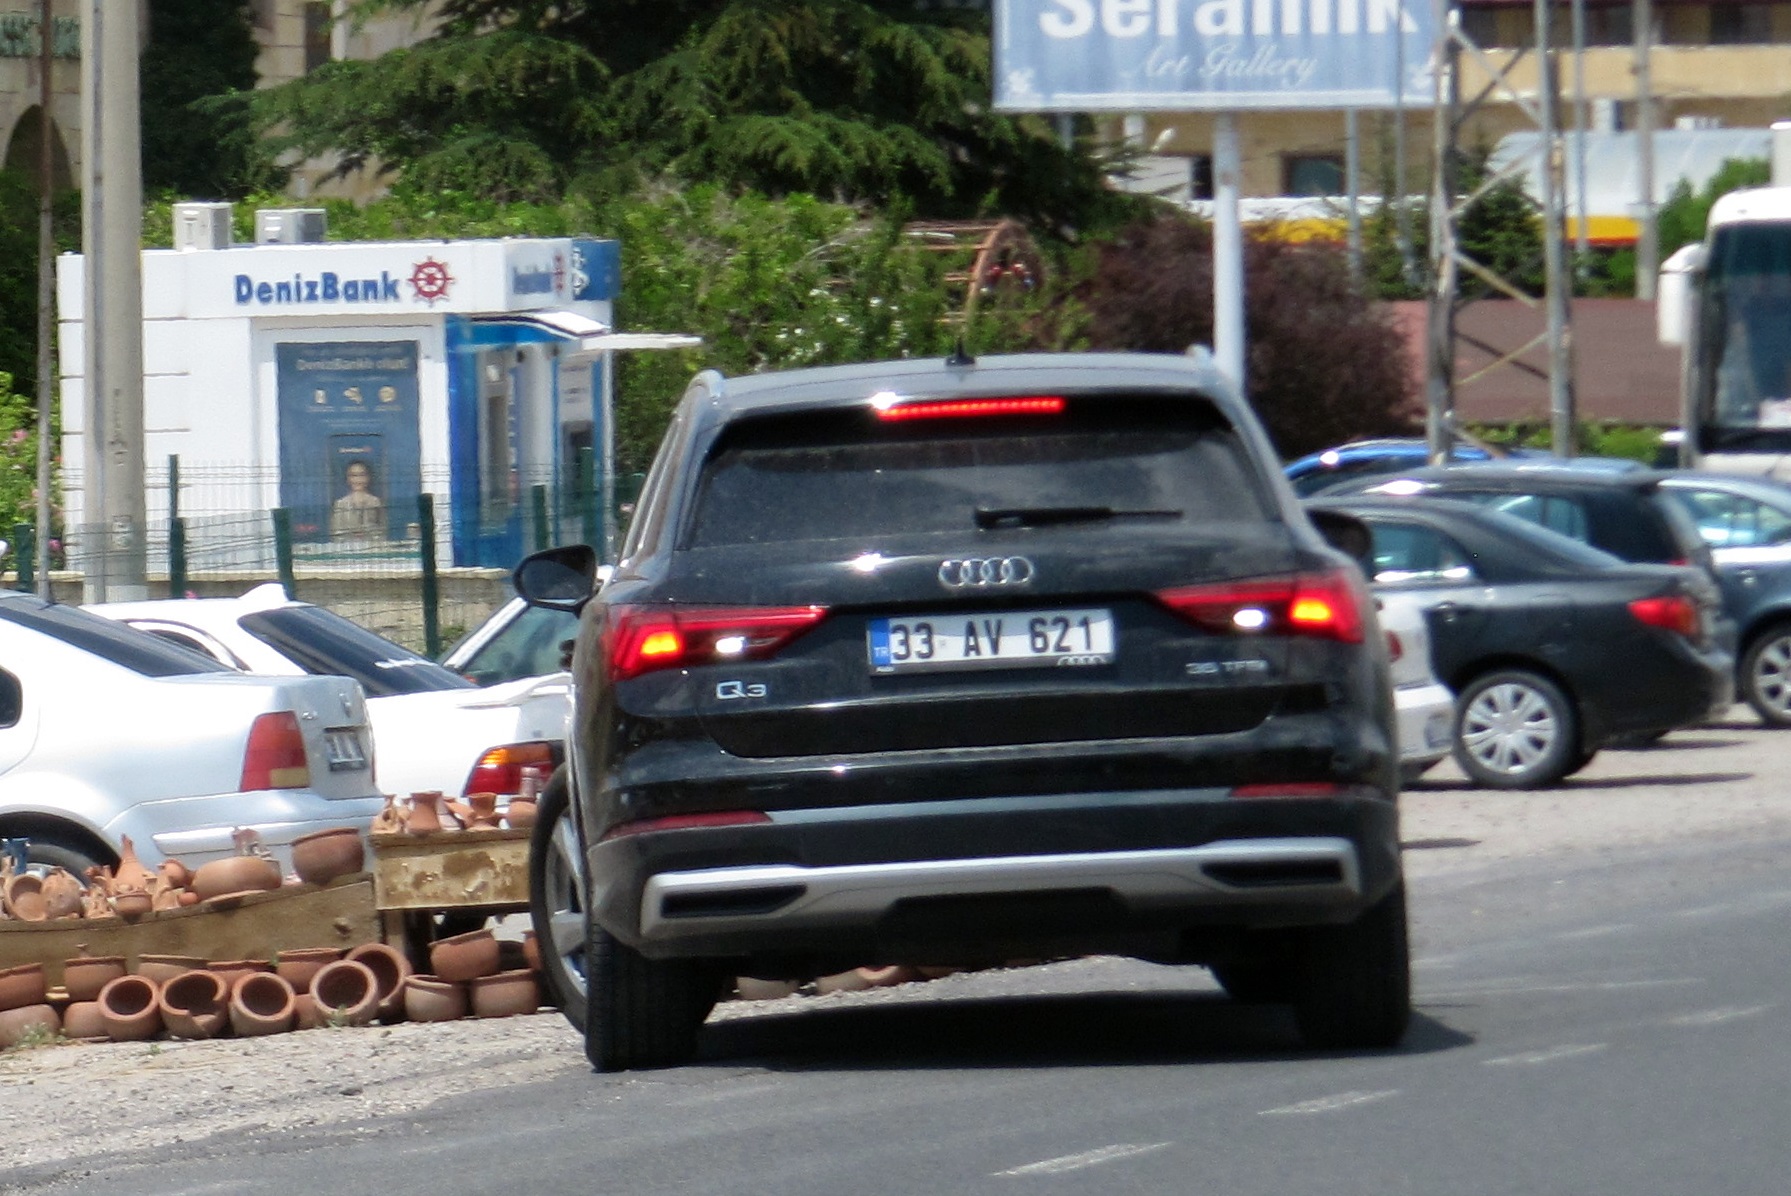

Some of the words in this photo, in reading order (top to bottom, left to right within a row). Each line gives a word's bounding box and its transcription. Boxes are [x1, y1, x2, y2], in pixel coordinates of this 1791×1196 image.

[1198, 43, 1318, 85] Gallery
[234, 270, 400, 304] DenizBank
[889, 622, 936, 661] 33
[963, 619, 1002, 657] AV
[1029, 615, 1094, 653] 621
[716, 681, 767, 700] Q3
